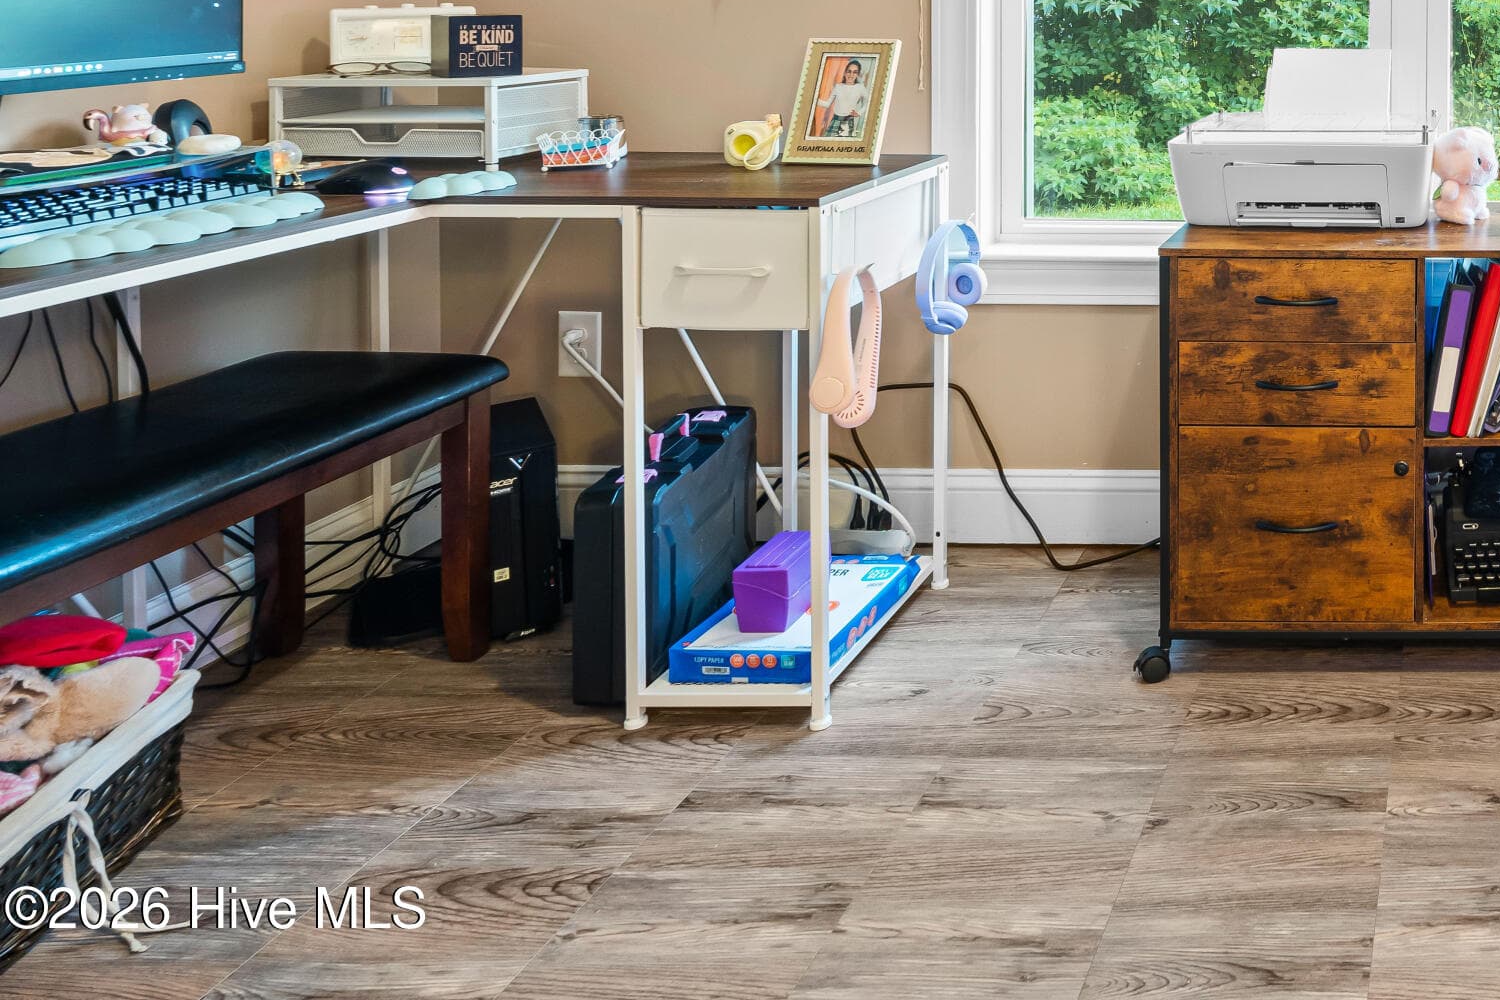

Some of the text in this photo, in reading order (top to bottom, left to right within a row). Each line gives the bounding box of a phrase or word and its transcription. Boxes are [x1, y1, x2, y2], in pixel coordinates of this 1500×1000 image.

[459, 29, 514, 45] BE KIND
[459, 51, 514, 68] BE QUIET
[796, 145, 835, 153] GRANDMA
[489, 476, 518, 489] acer
